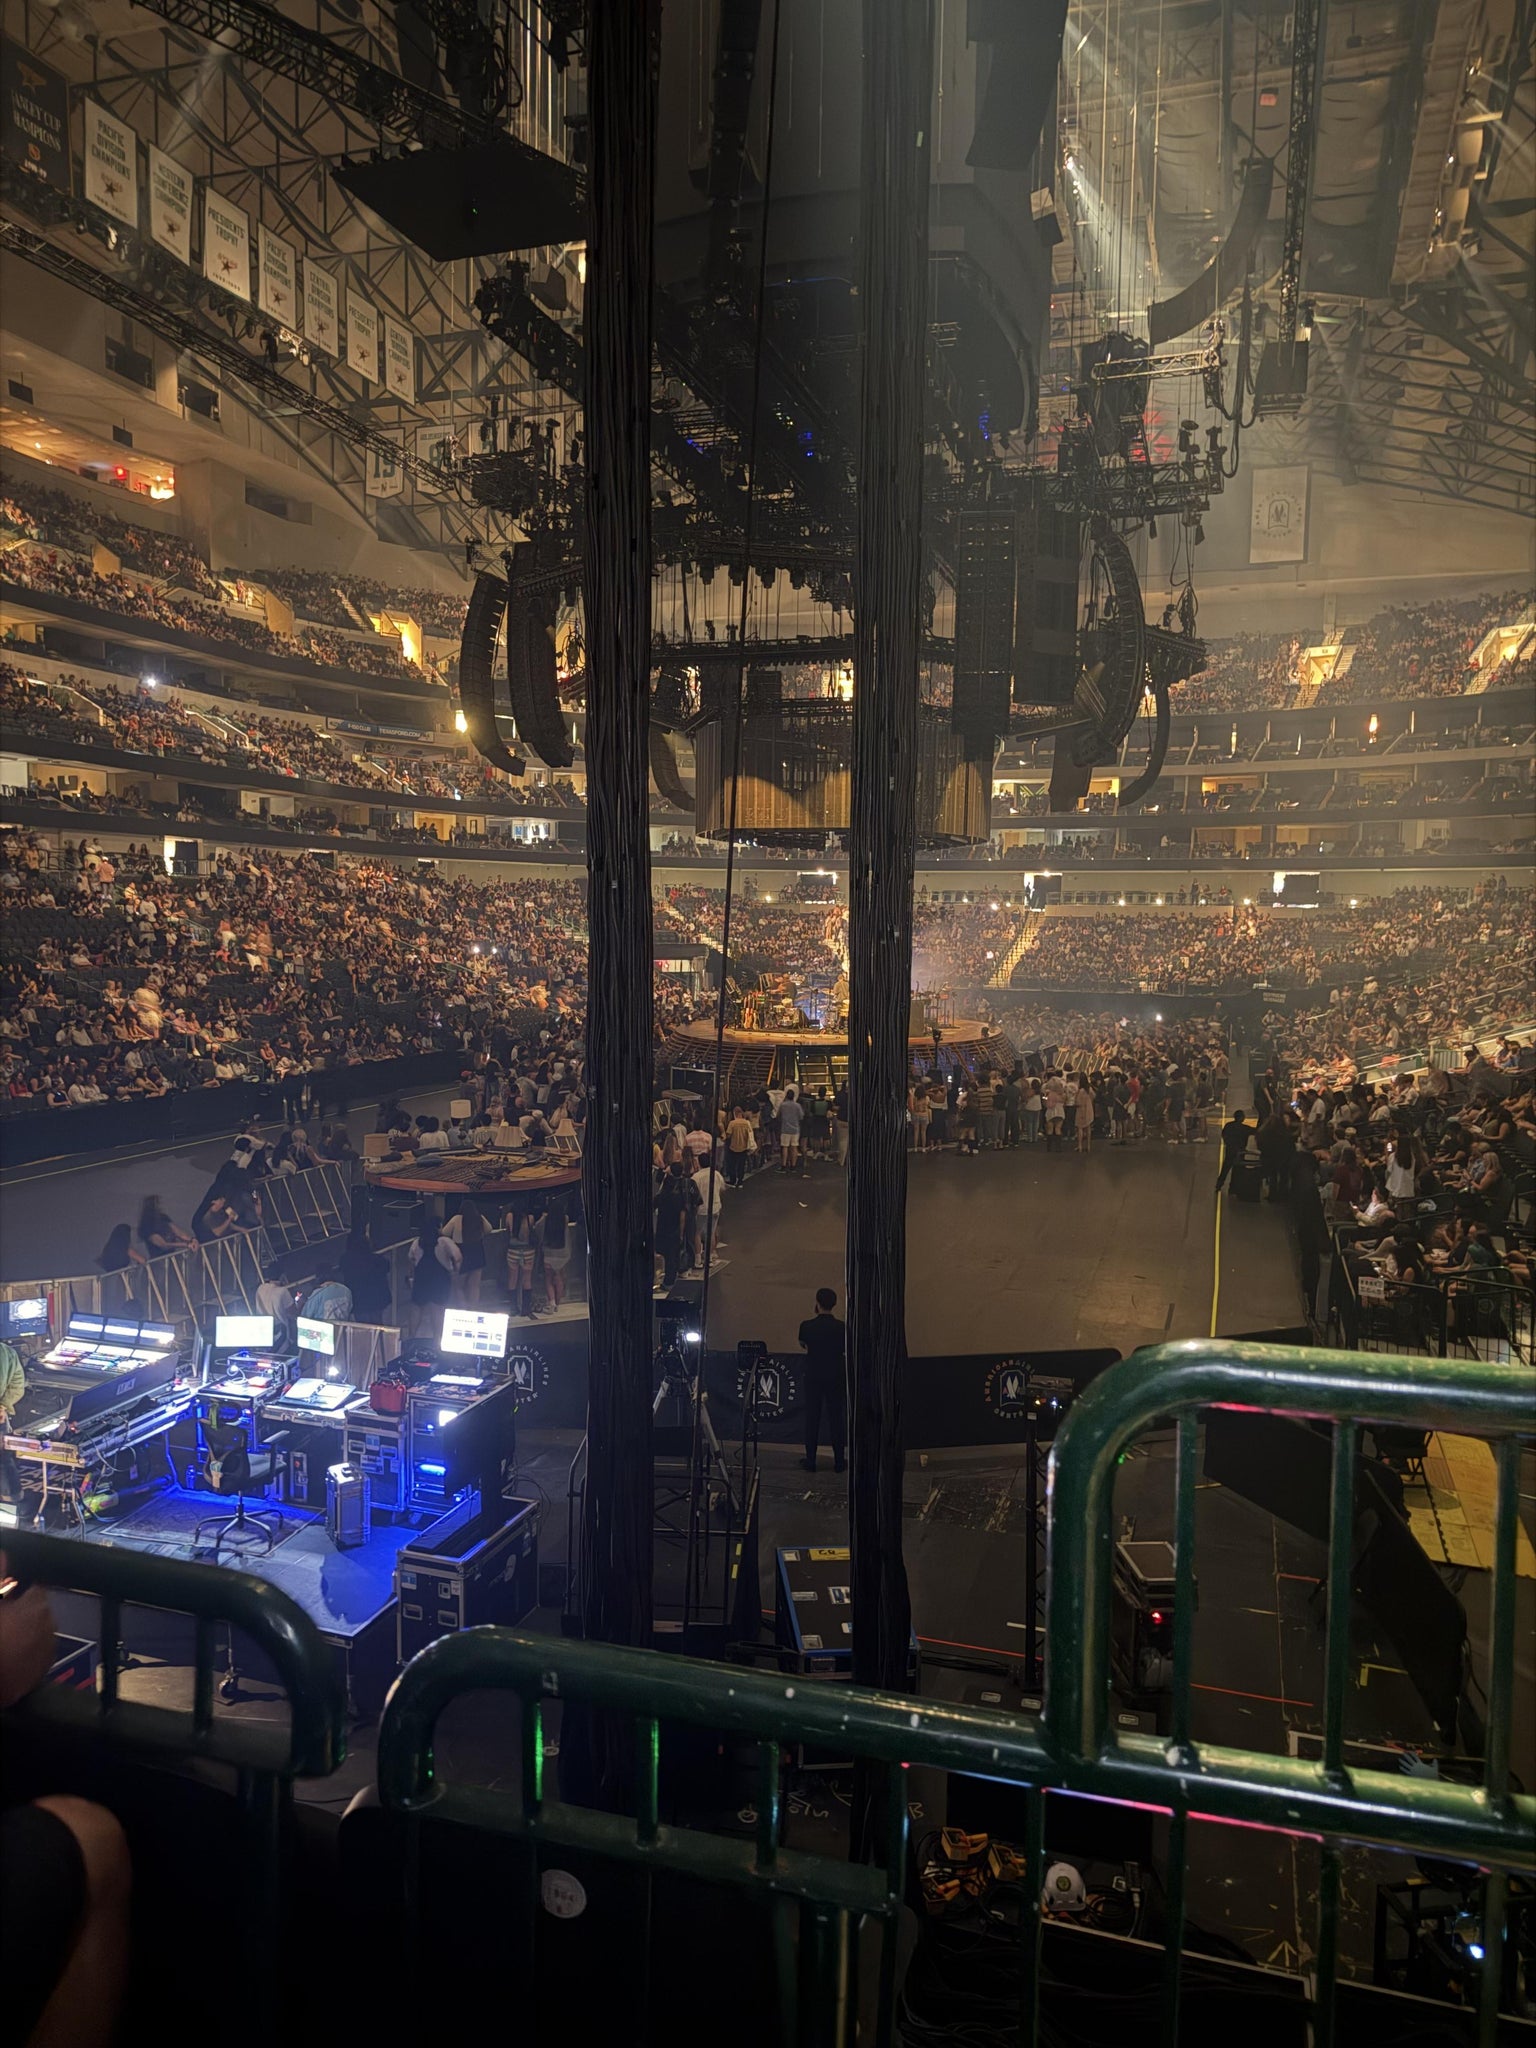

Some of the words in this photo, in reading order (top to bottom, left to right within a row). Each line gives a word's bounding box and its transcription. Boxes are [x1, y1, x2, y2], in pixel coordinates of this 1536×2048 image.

[97, 133, 126, 161] DIVISION
[98, 119, 125, 147] PACIFIC
[91, 144, 131, 180] CHAMPIONS
[215, 224, 238, 248] TROPHY
[984, 1359, 1014, 1402] AMERICAN
